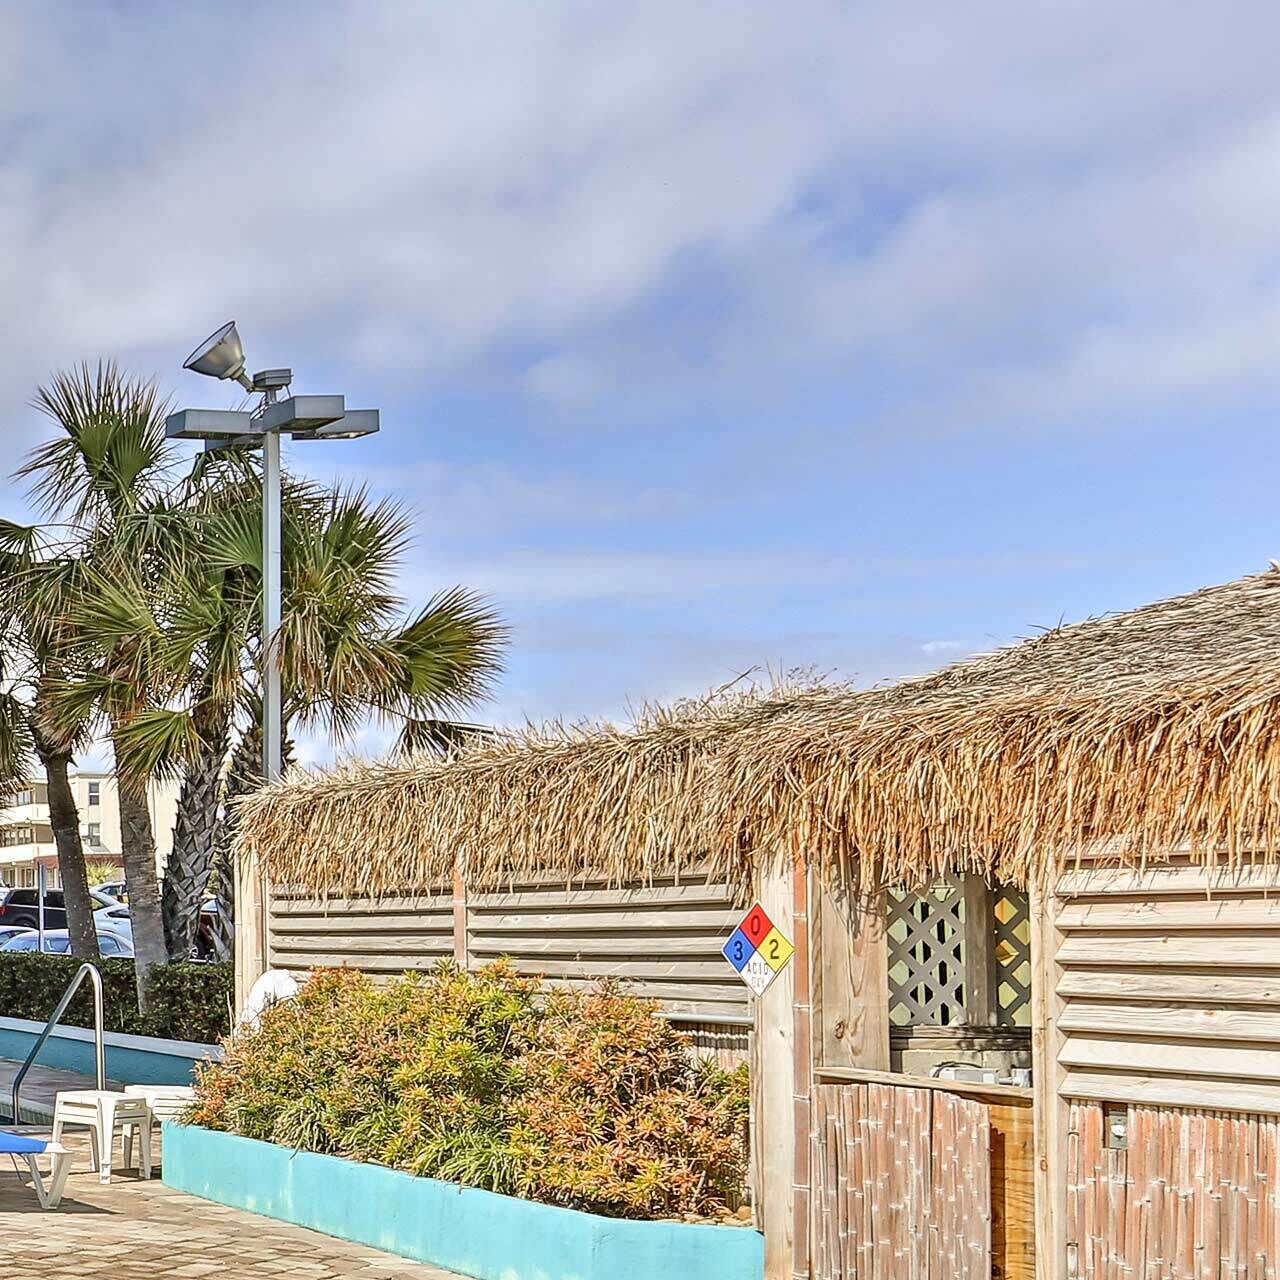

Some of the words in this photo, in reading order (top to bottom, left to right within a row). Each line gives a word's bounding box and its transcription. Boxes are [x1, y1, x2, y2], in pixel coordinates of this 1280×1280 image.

[751, 915, 761, 936] 0
[733, 940, 743, 961] 3
[769, 939, 779, 960] 2
[747, 962, 769, 975] ACID
